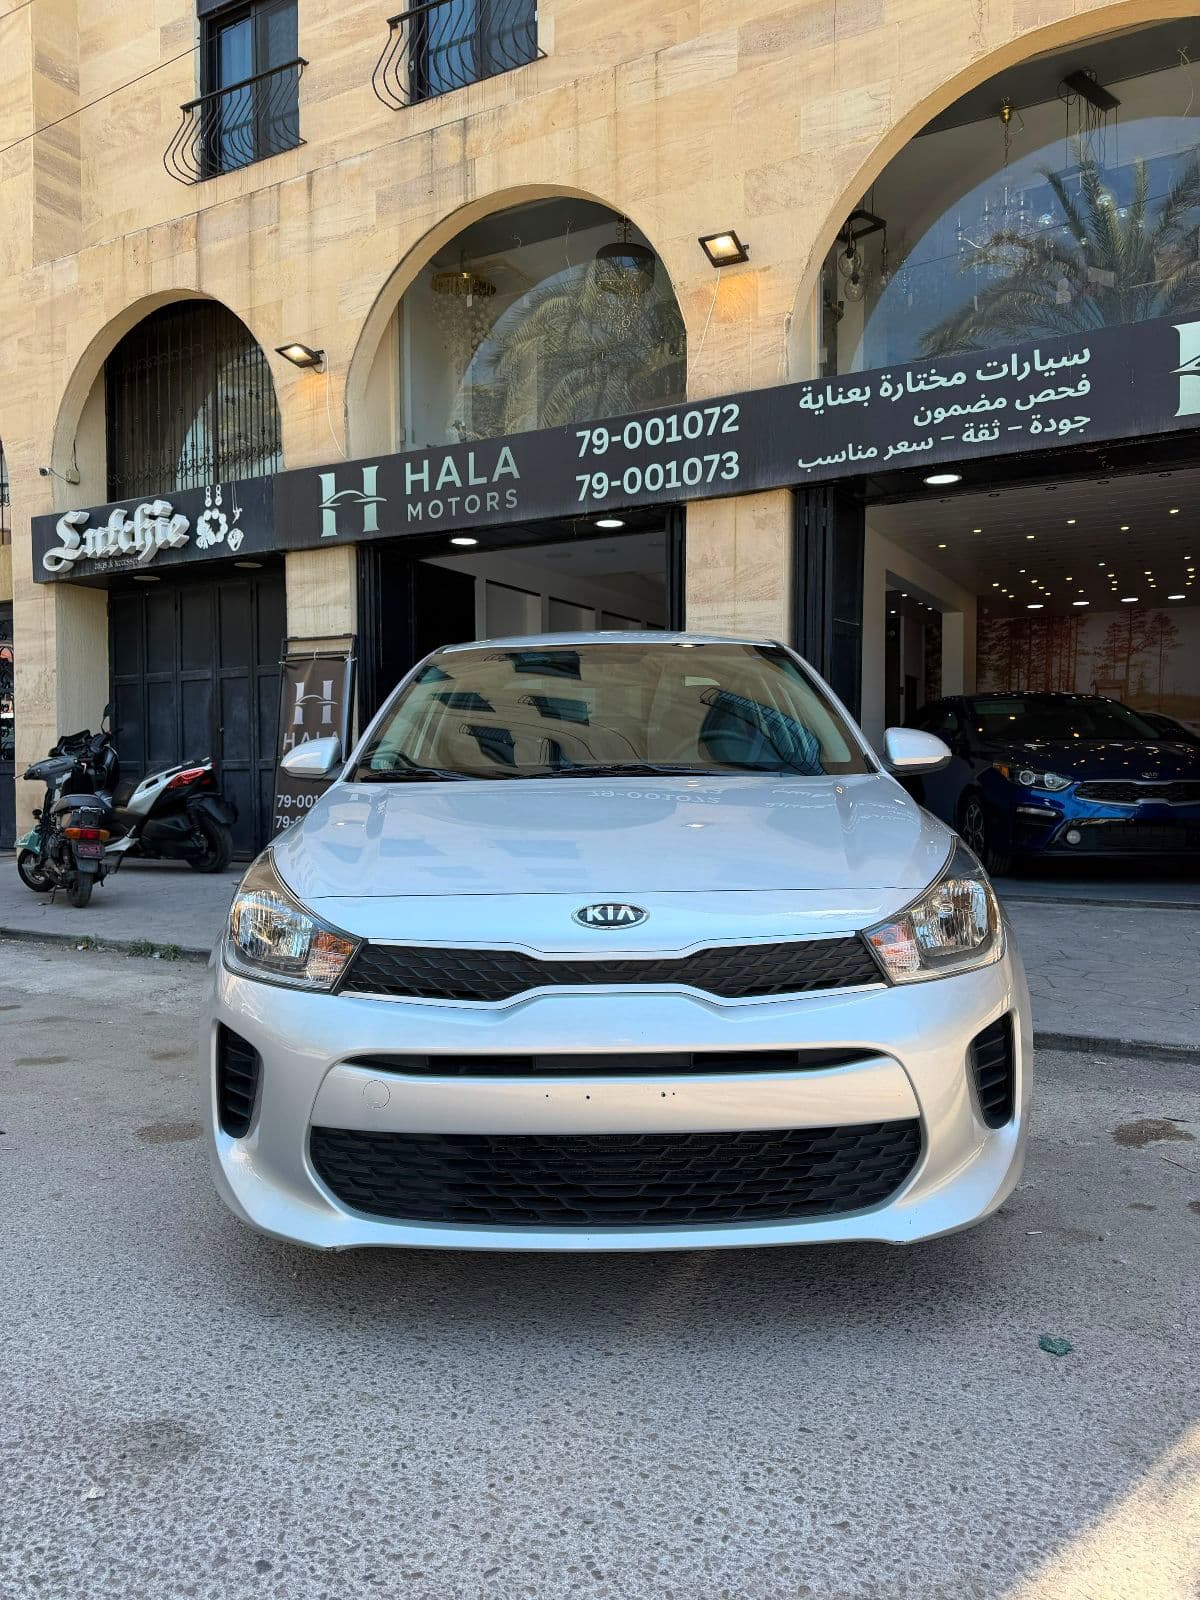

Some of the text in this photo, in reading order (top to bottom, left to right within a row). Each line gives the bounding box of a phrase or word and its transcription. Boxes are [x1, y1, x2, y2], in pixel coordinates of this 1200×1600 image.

[799, 346, 1091, 416] سيارات مختارة بعناية
[913, 373, 1091, 427] فحص مضمون
[575, 403, 740, 458] 79-001072
[961, 419, 1000, 443] ثقة
[1029, 413, 1091, 435] جودة
[797, 444, 878, 472] مناسب
[884, 437, 934, 461] سعر
[405, 446, 521, 495] HALA
[575, 452, 740, 502] 79-001073
[407, 489, 519, 523] MOTORS
[586, 906, 635, 921] KIA
